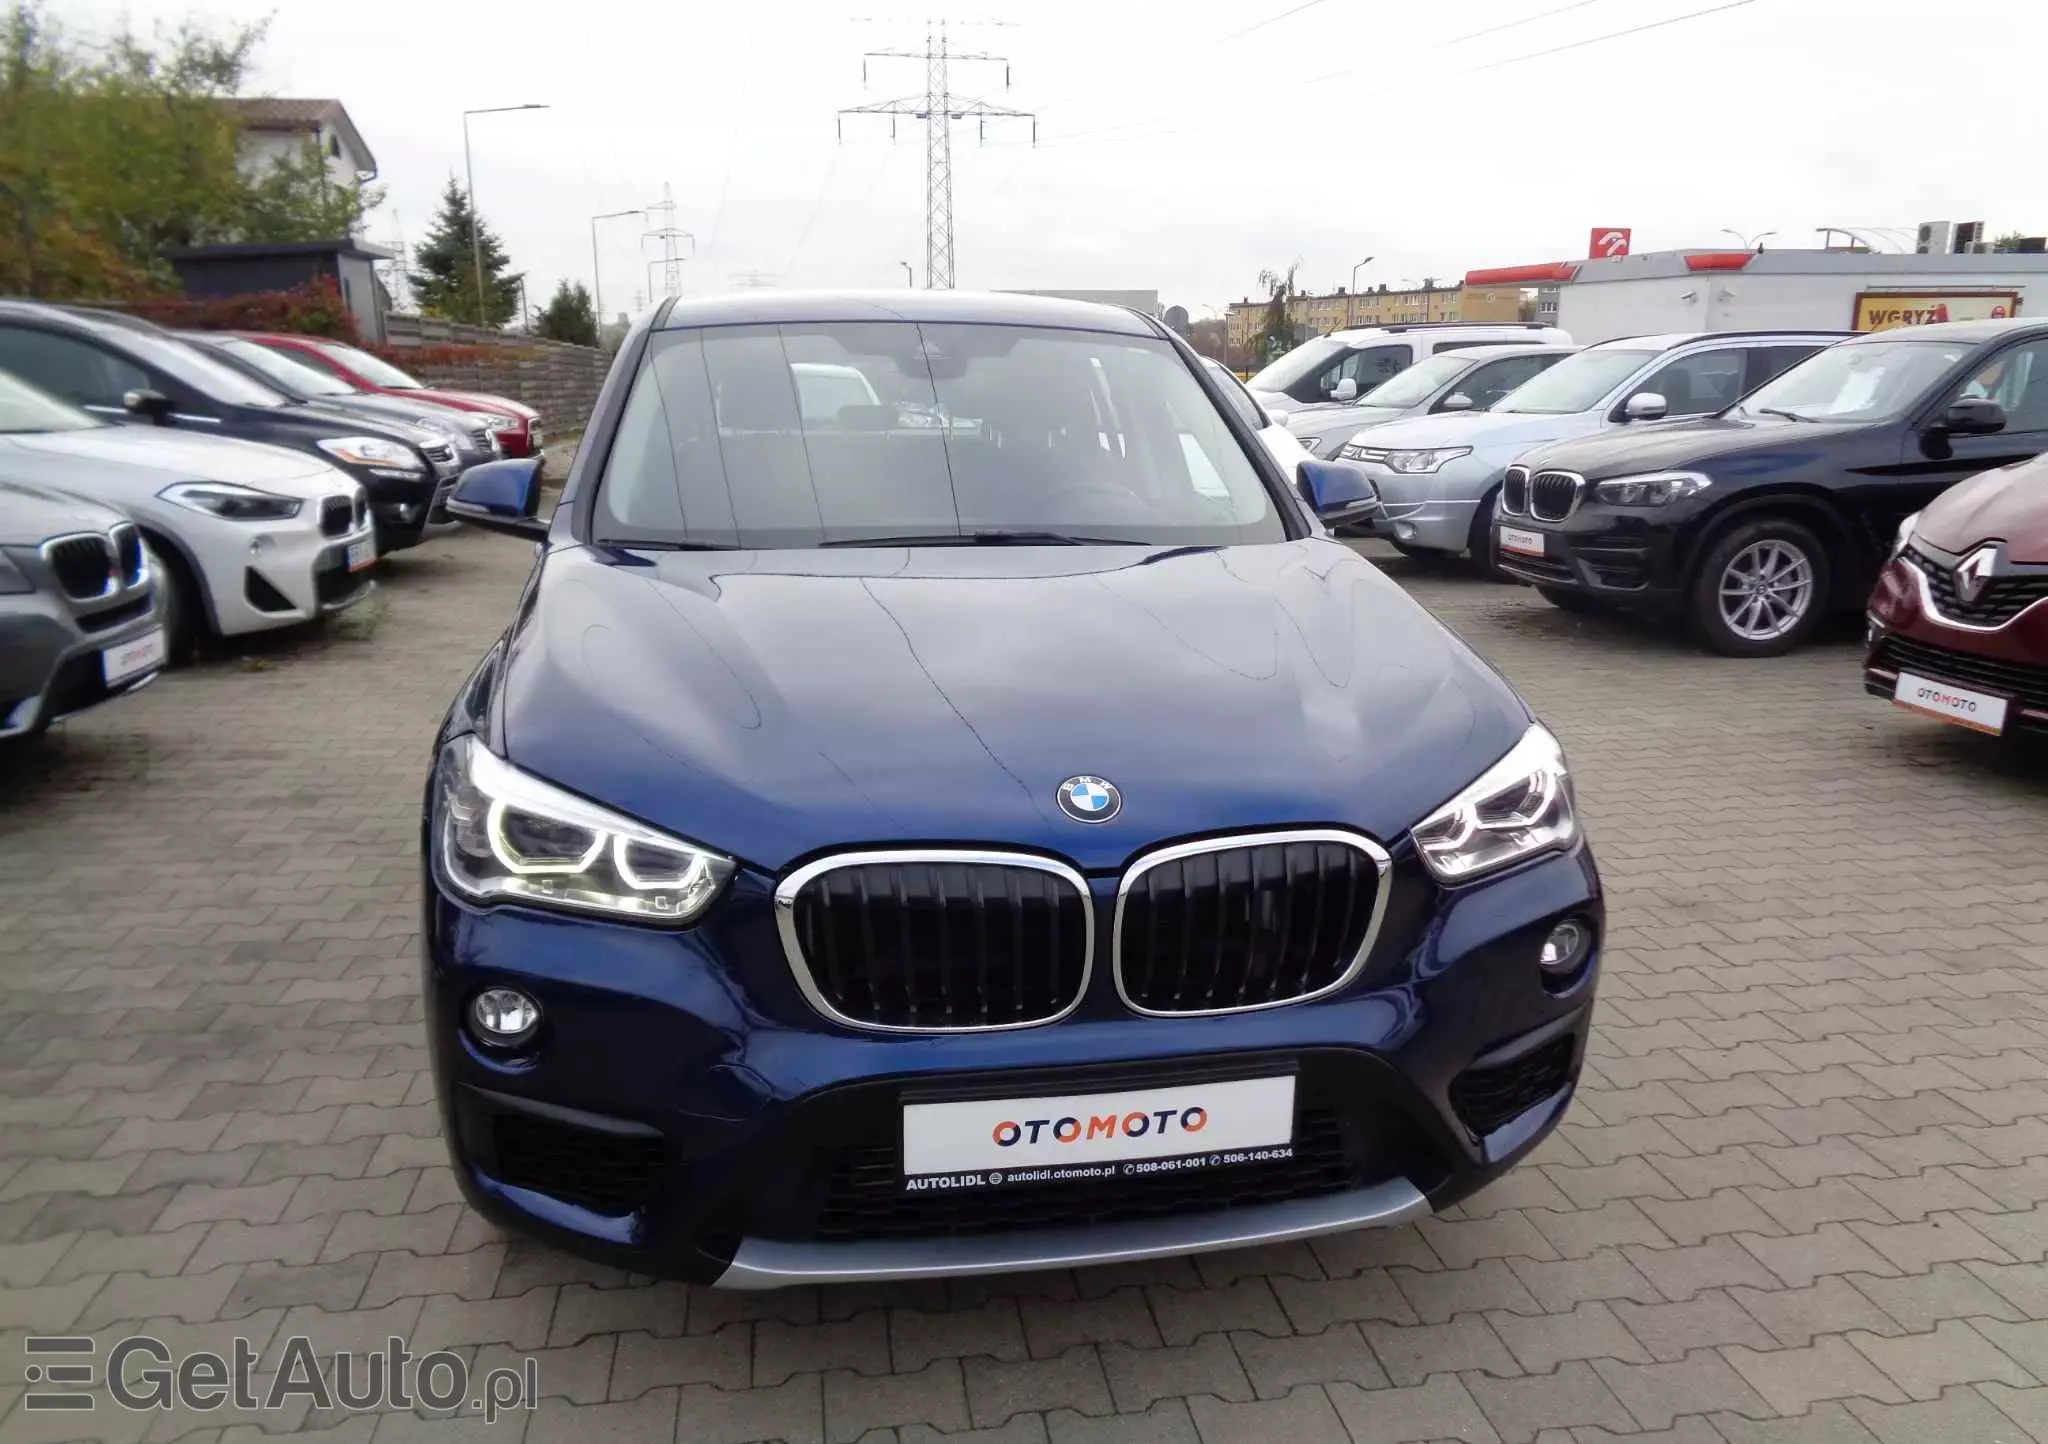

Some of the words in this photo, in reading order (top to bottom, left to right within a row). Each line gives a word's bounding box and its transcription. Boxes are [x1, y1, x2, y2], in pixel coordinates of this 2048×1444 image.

[1917, 687, 1977, 712] OTOMOTO
[1061, 776, 1114, 791] BMW
[992, 1106, 1208, 1147] OTOMOTO
[906, 1174, 986, 1190] AUTOLIDL
[1007, 1165, 1115, 1183] autolidl.otomoto.pl
